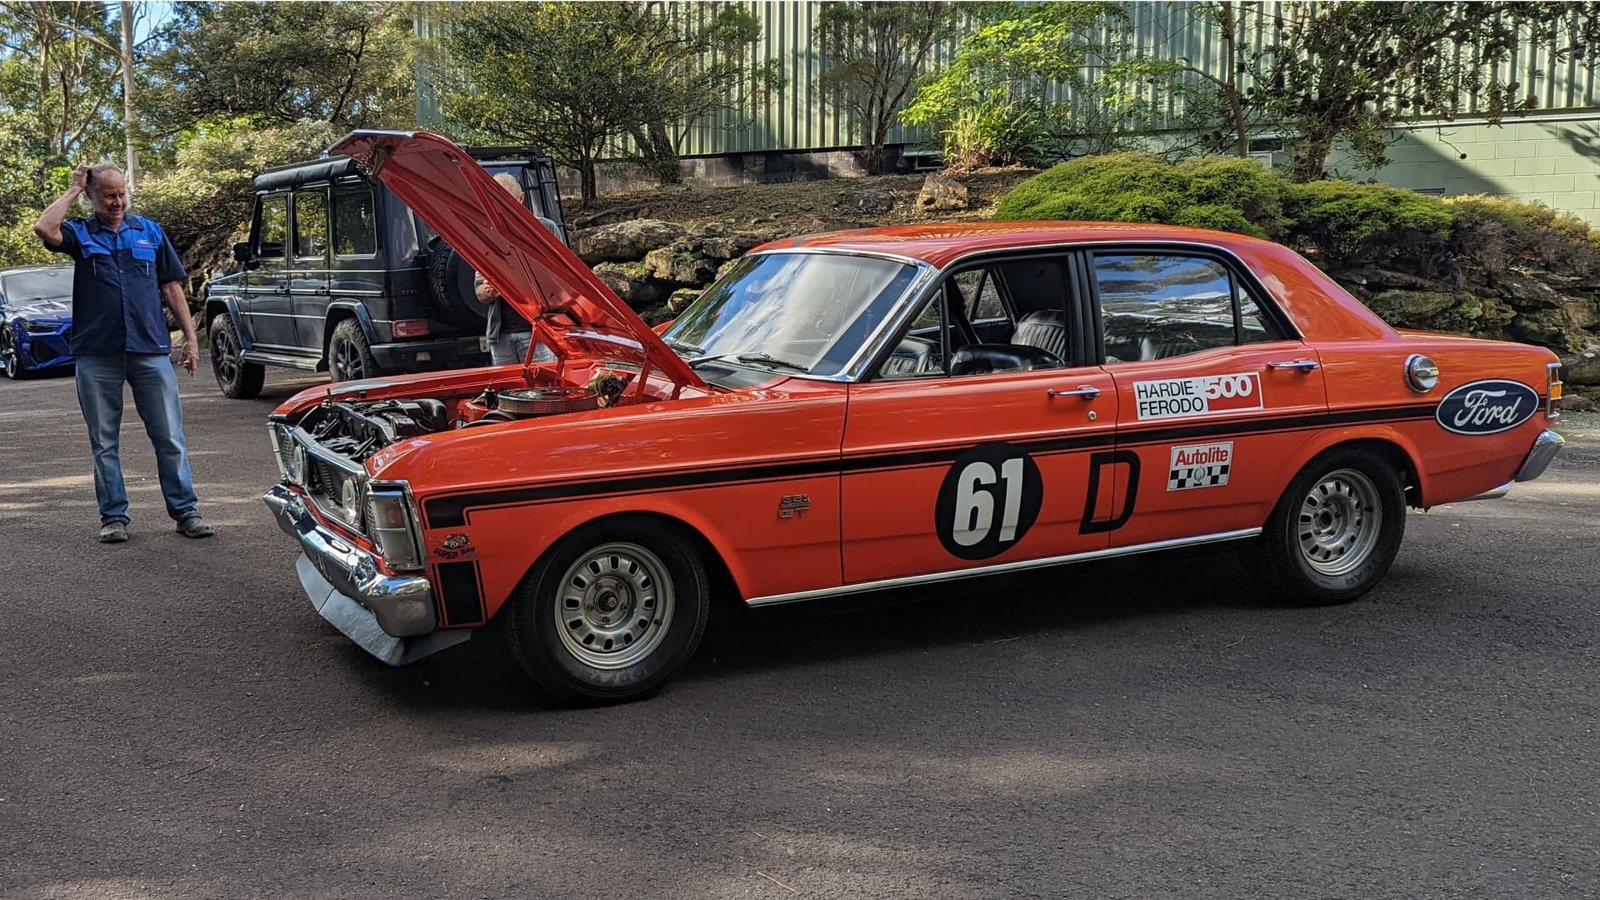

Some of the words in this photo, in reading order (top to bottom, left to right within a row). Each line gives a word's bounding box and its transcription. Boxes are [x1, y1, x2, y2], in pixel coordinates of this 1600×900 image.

[1204, 374, 1252, 400] 500
[1140, 397, 1203, 416] FERODO
[1454, 390, 1522, 427] Ford
[1175, 447, 1228, 466] Autolite
[953, 457, 1024, 546] 61
[1078, 450, 1141, 535] D
